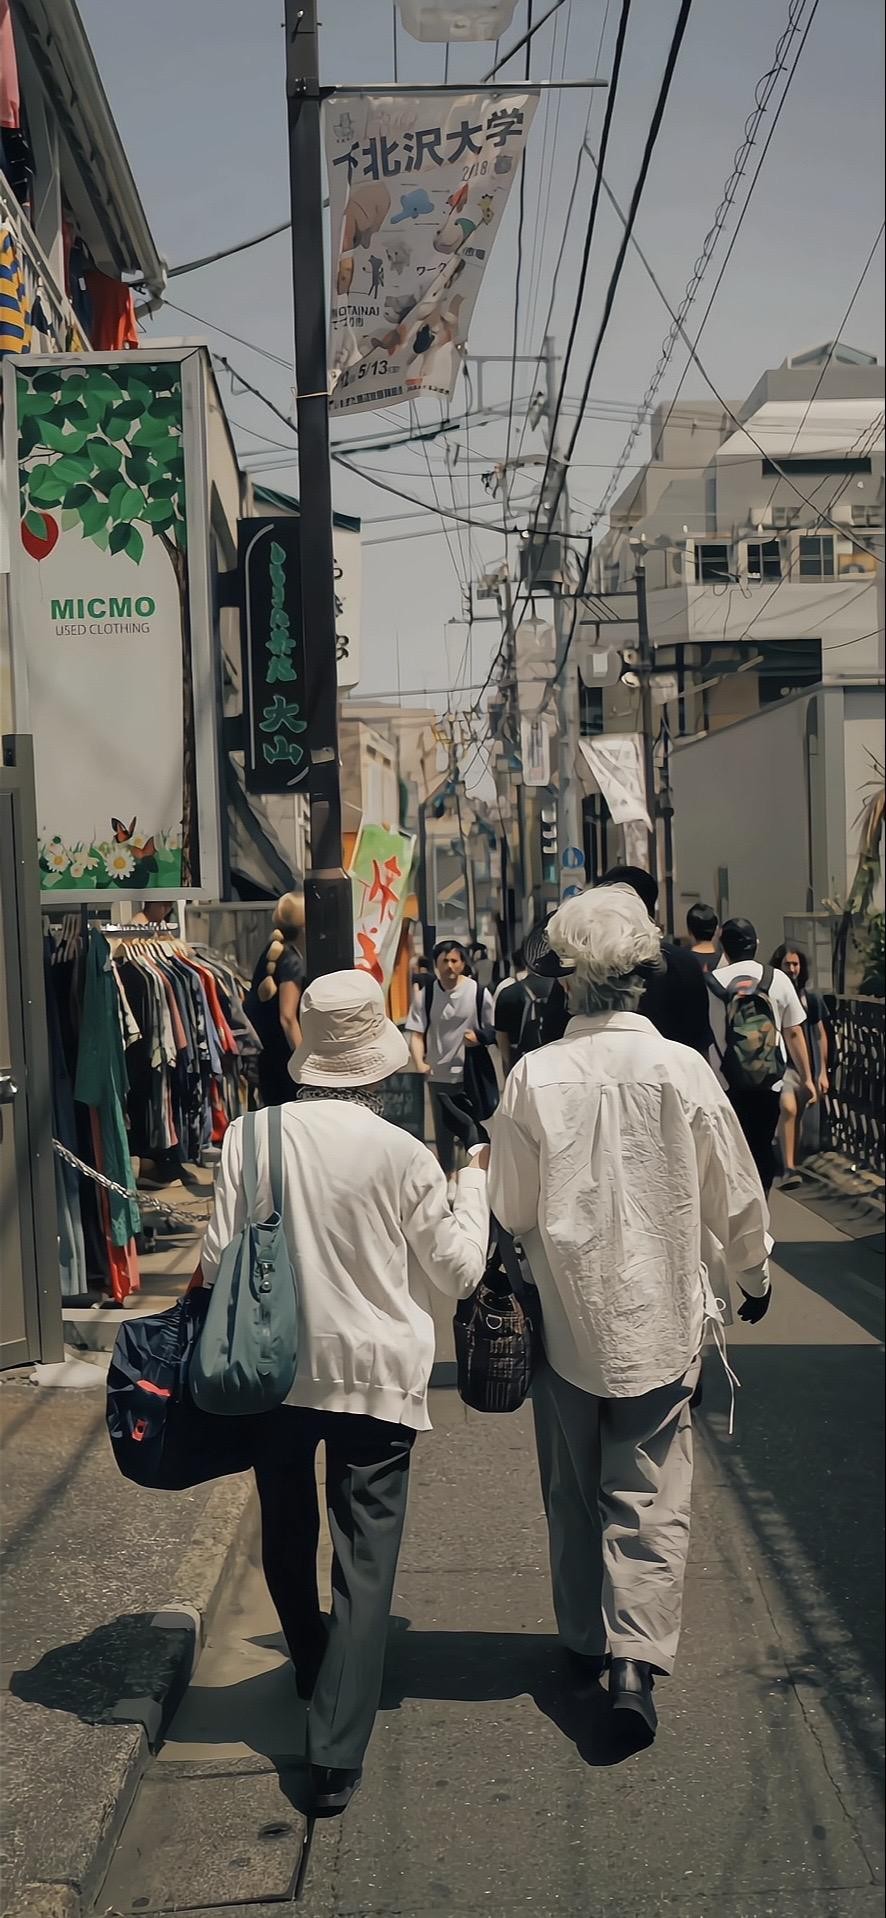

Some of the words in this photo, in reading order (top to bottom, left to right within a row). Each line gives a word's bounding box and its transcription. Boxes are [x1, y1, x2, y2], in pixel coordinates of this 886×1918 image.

[333, 108, 524, 185] 下北沢大学
[51, 597, 155, 619] MICMO
[56, 624, 87, 636] USED
[89, 622, 150, 635] CLOTHING
